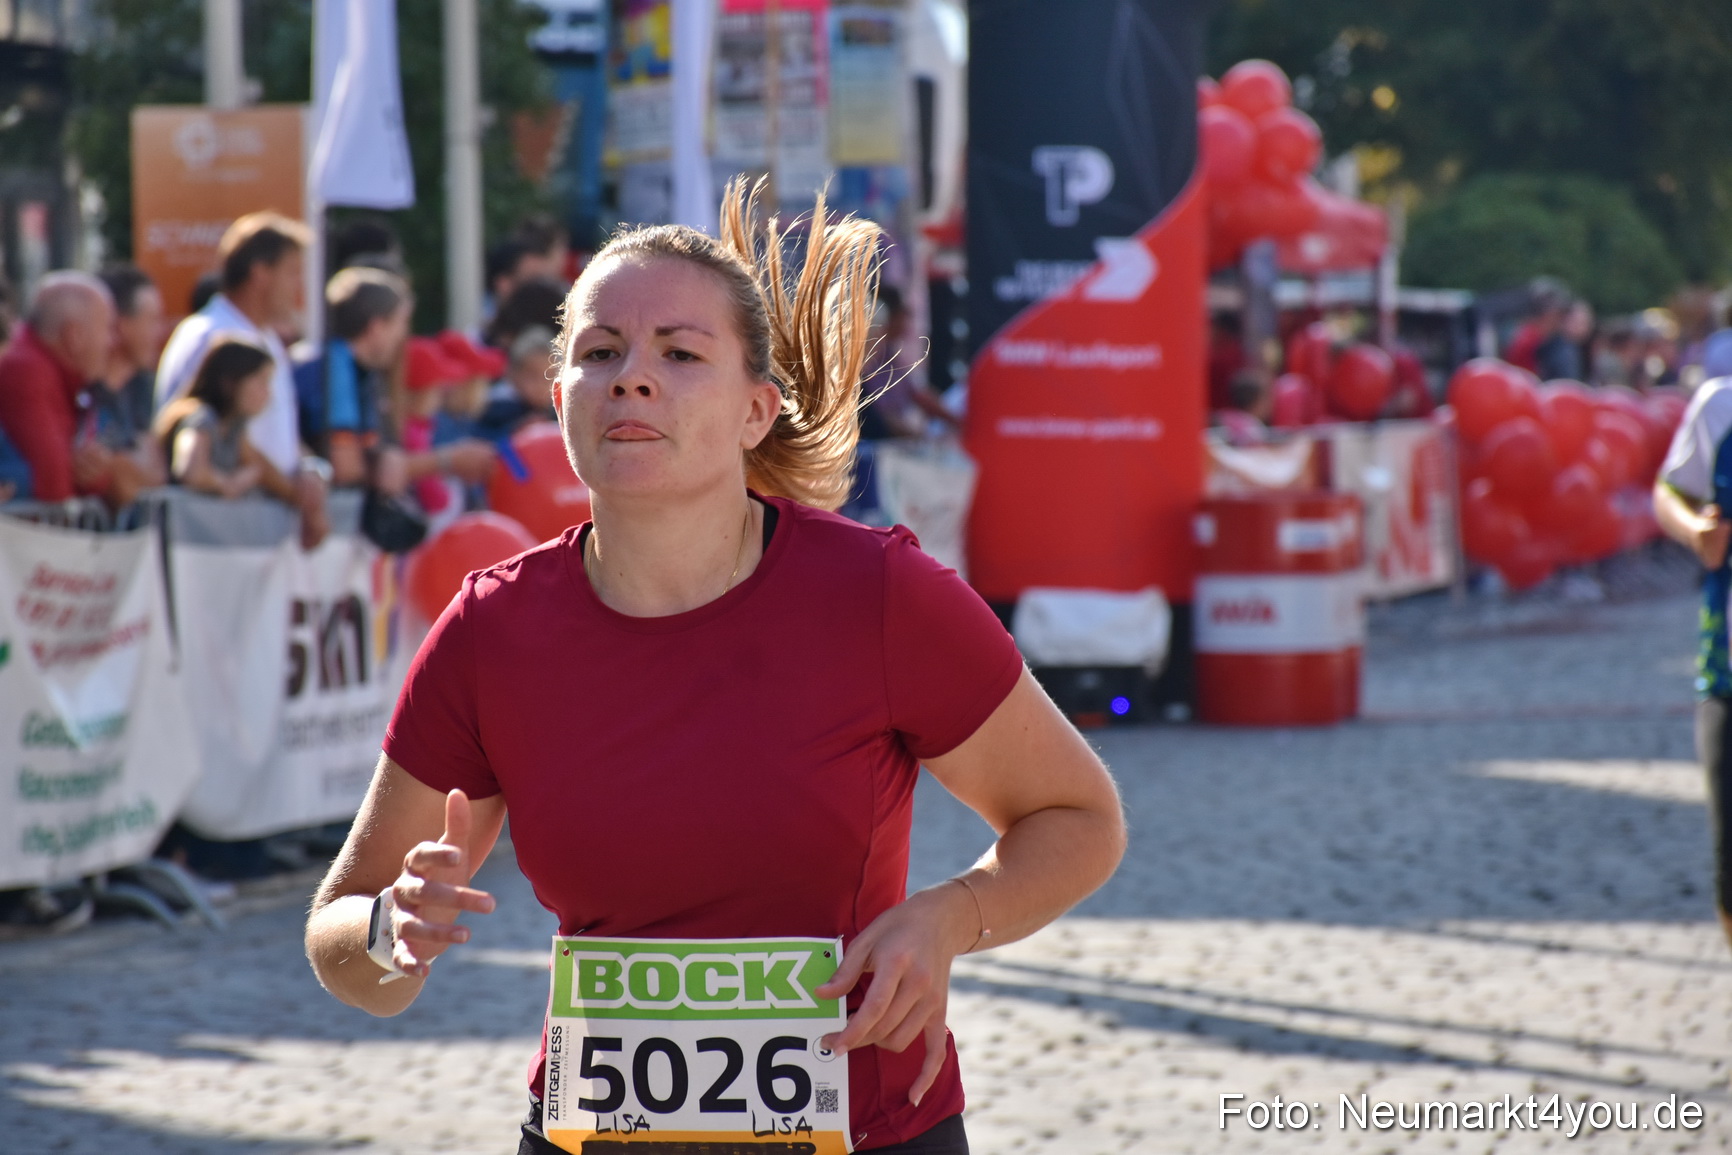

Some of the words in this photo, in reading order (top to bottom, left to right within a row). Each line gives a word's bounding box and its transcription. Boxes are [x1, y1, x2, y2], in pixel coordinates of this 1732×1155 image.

[575, 956, 808, 1006] BOCK
[577, 1035, 812, 1115] 5026
[594, 1113, 651, 1135] LISA
[752, 1110, 813, 1139] LISA
